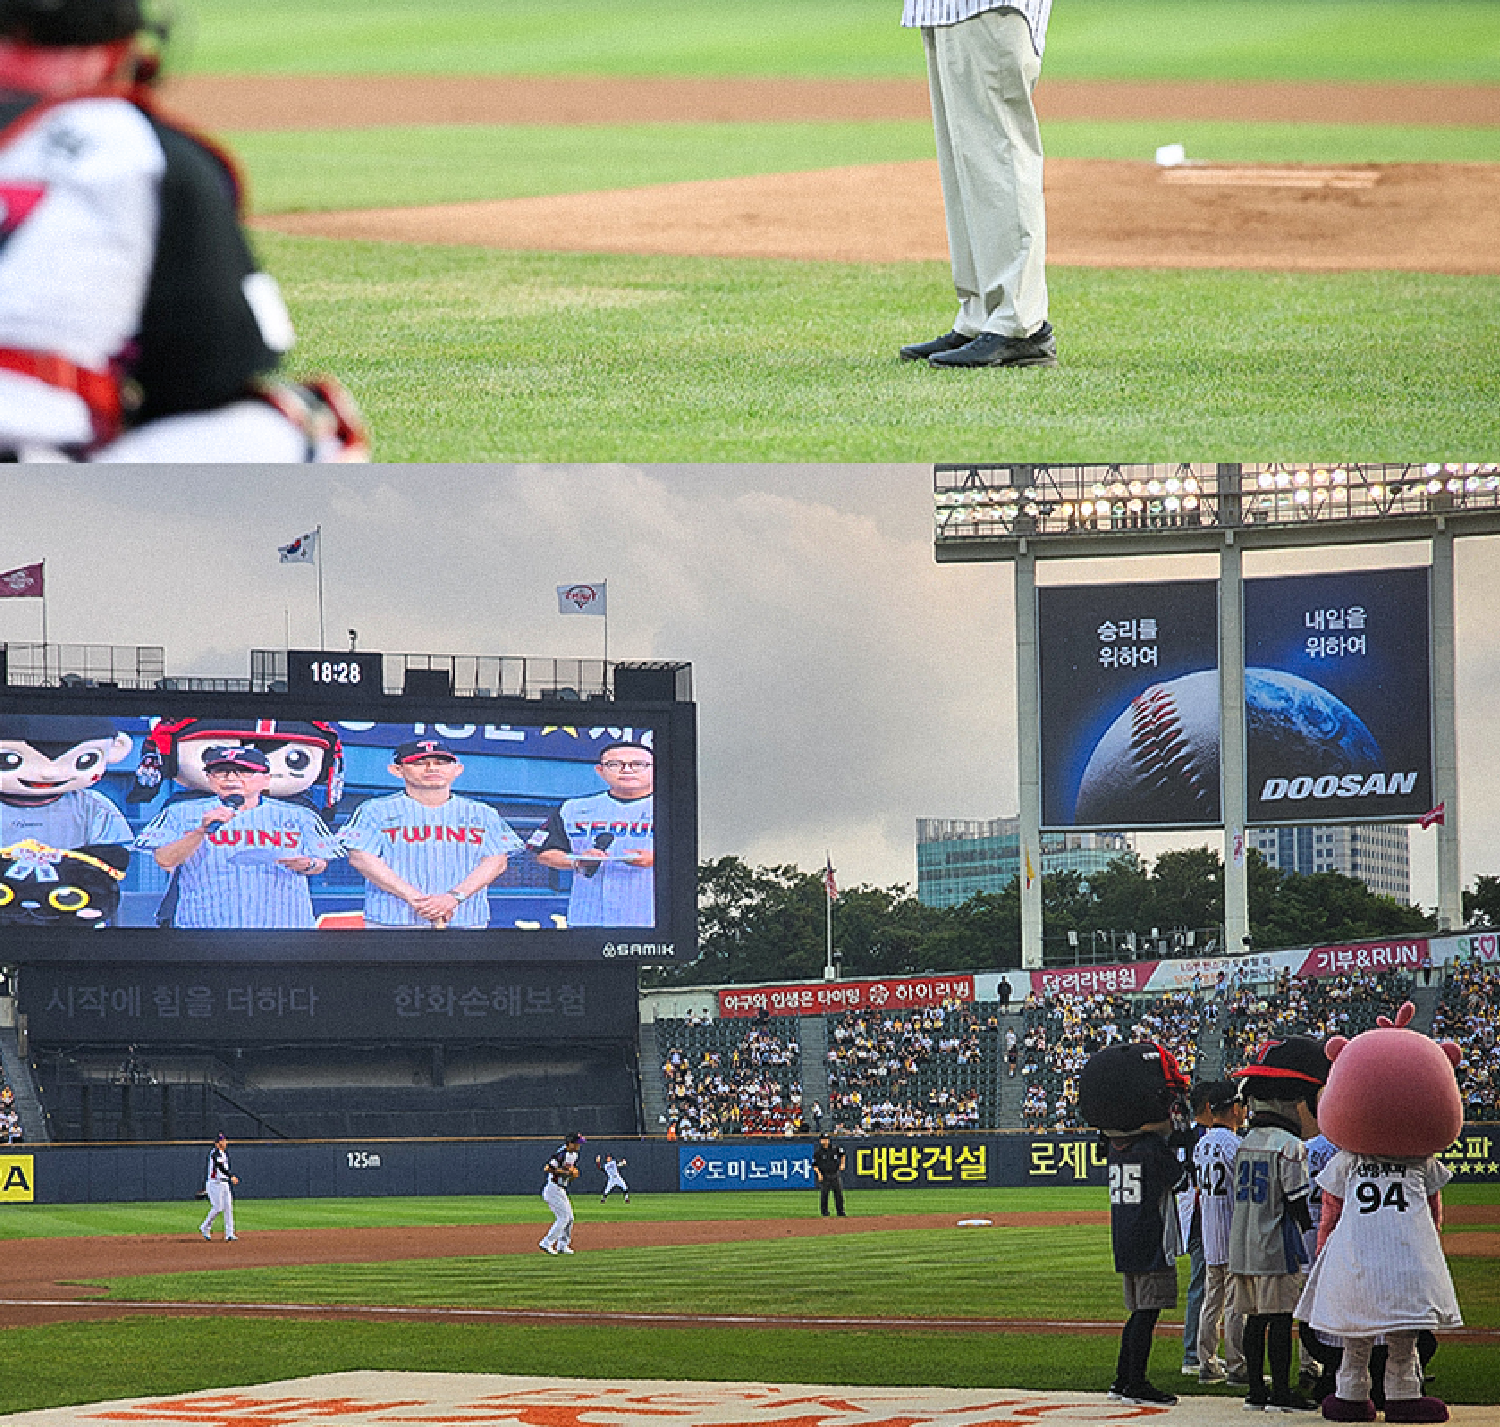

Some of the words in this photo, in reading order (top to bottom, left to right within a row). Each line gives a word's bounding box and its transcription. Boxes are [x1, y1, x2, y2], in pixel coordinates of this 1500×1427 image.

[1097, 618, 1158, 641] 승리를
[1305, 605, 1368, 631] 내일을
[1099, 645, 1158, 668] 위하여
[1306, 634, 1366, 659] 위하여
[310, 661, 362, 684] 18:28
[1260, 771, 1418, 802] DOOSAN
[209, 828, 302, 849] WINS
[381, 825, 486, 845] TWINS
[617, 941, 675, 957] SAMIK
[1317, 943, 1419, 972] 기부&RUN
[45, 984, 142, 1019] 시작에
[152, 983, 217, 1018] 힘을
[226, 984, 320, 1018] 더하다
[394, 983, 588, 1018] 한화손해보험
[895, 980, 970, 1001] 하이리빙
[346, 1151, 381, 1168] 125m
[706, 1159, 811, 1181] 도미노피자
[856, 1145, 988, 1181] 대방건설
[1108, 1163, 1142, 1204] 25
[1355, 1181, 1409, 1213] 94
